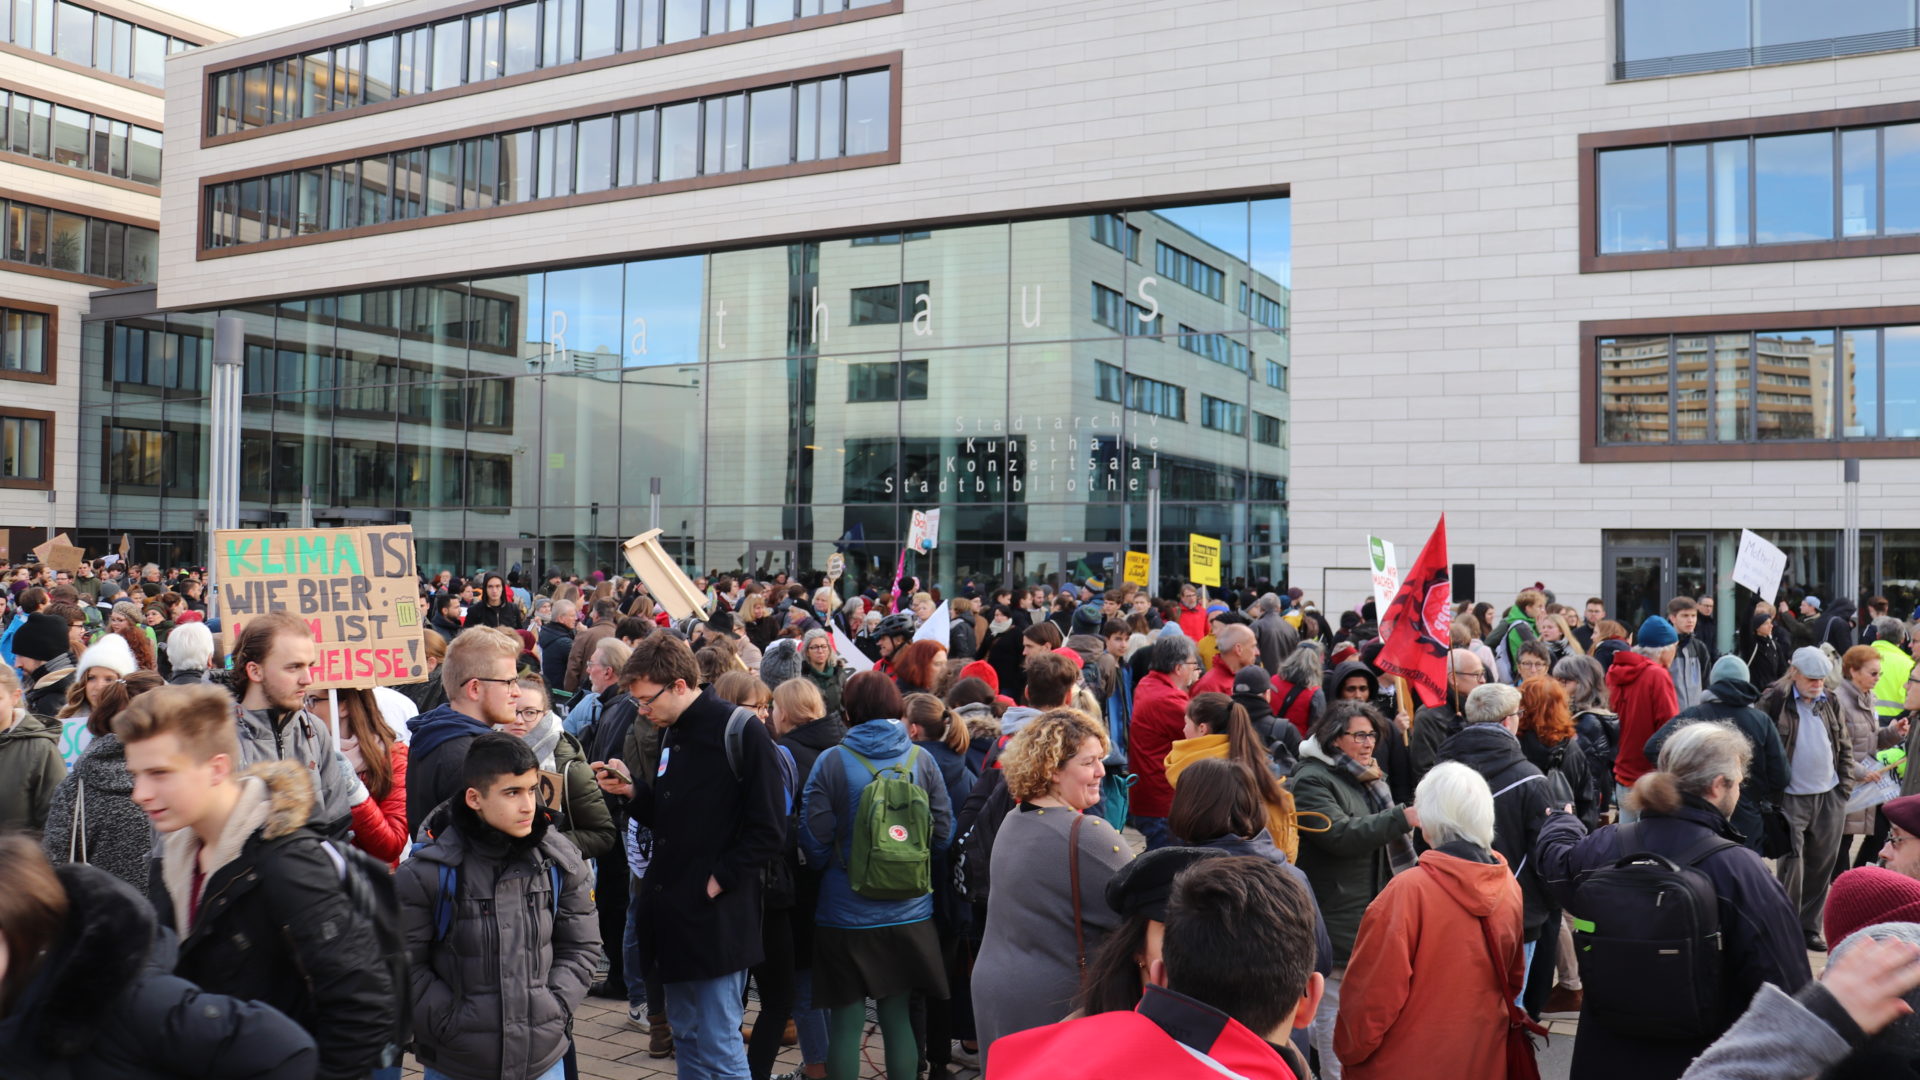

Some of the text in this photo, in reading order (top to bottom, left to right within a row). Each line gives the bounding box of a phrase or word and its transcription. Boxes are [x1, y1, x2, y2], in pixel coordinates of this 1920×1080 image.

[550, 277, 1160, 362] Rathaus
[956, 411, 1158, 432] Stadtarchiv
[966, 433, 1159, 453] Kunsthalle
[946, 452, 1157, 473] Konzertsaal
[884, 470, 1139, 494] Stadtbibliothe
[226, 531, 414, 578] KLIMA IST
[225, 579, 288, 615] WIE
[335, 614, 388, 642] IST
[309, 638, 423, 682] HEISSE!
